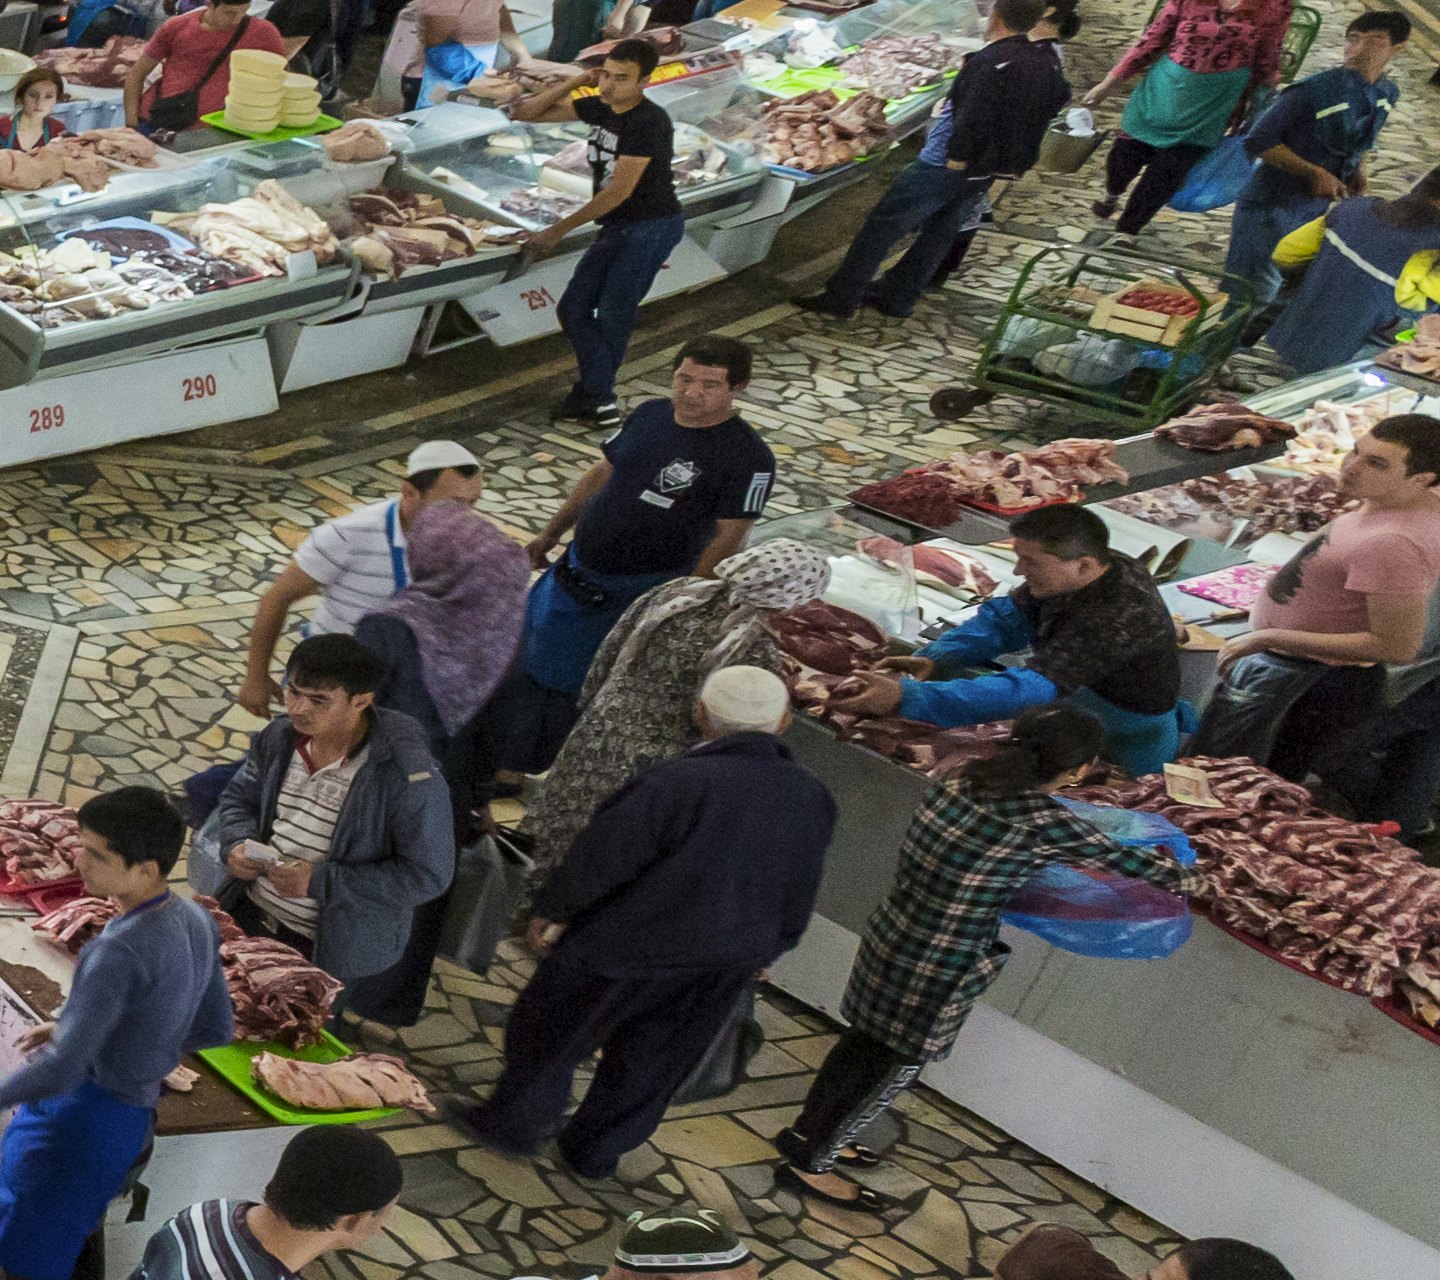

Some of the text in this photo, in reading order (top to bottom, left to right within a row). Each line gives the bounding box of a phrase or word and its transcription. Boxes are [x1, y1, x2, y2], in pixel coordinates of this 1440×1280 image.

[520, 288, 558, 312] 291
[182, 374, 217, 402] 290
[29, 404, 65, 433] 289
